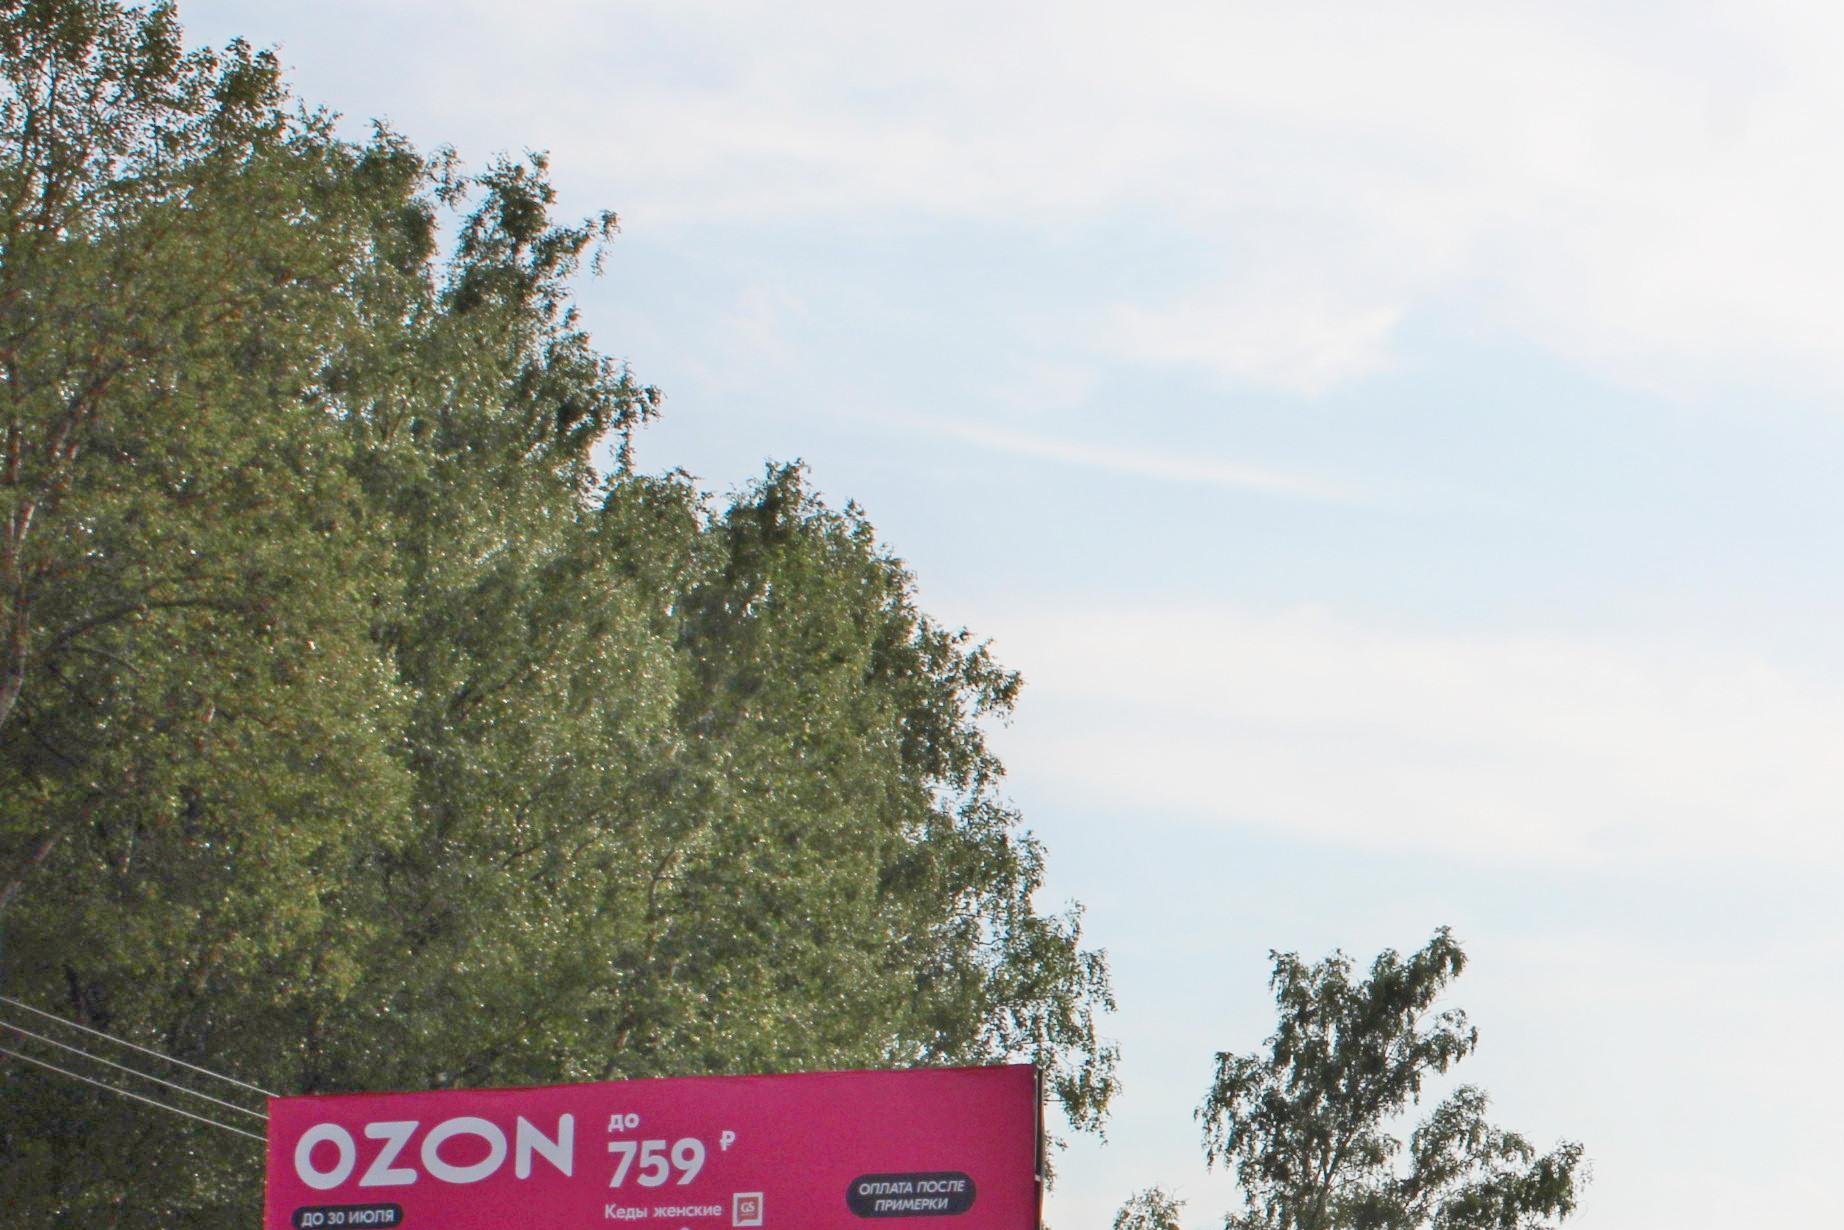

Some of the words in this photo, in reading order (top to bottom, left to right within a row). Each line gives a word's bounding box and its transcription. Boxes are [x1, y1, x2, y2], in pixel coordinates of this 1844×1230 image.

[294, 1113, 575, 1190] OZON
[608, 1137, 706, 1189] 759
[859, 1182, 913, 1195] ОПЛАТА
[917, 1180, 965, 1193] ПОСЛЕ
[604, 1204, 648, 1221] Кеды
[653, 1203, 723, 1218] женские
[874, 1198, 949, 1212] ПРИМЕРКИ
[301, 1212, 324, 1228] ДО
[327, 1212, 344, 1225] 30
[348, 1209, 395, 1224] ИЮЛЯ
